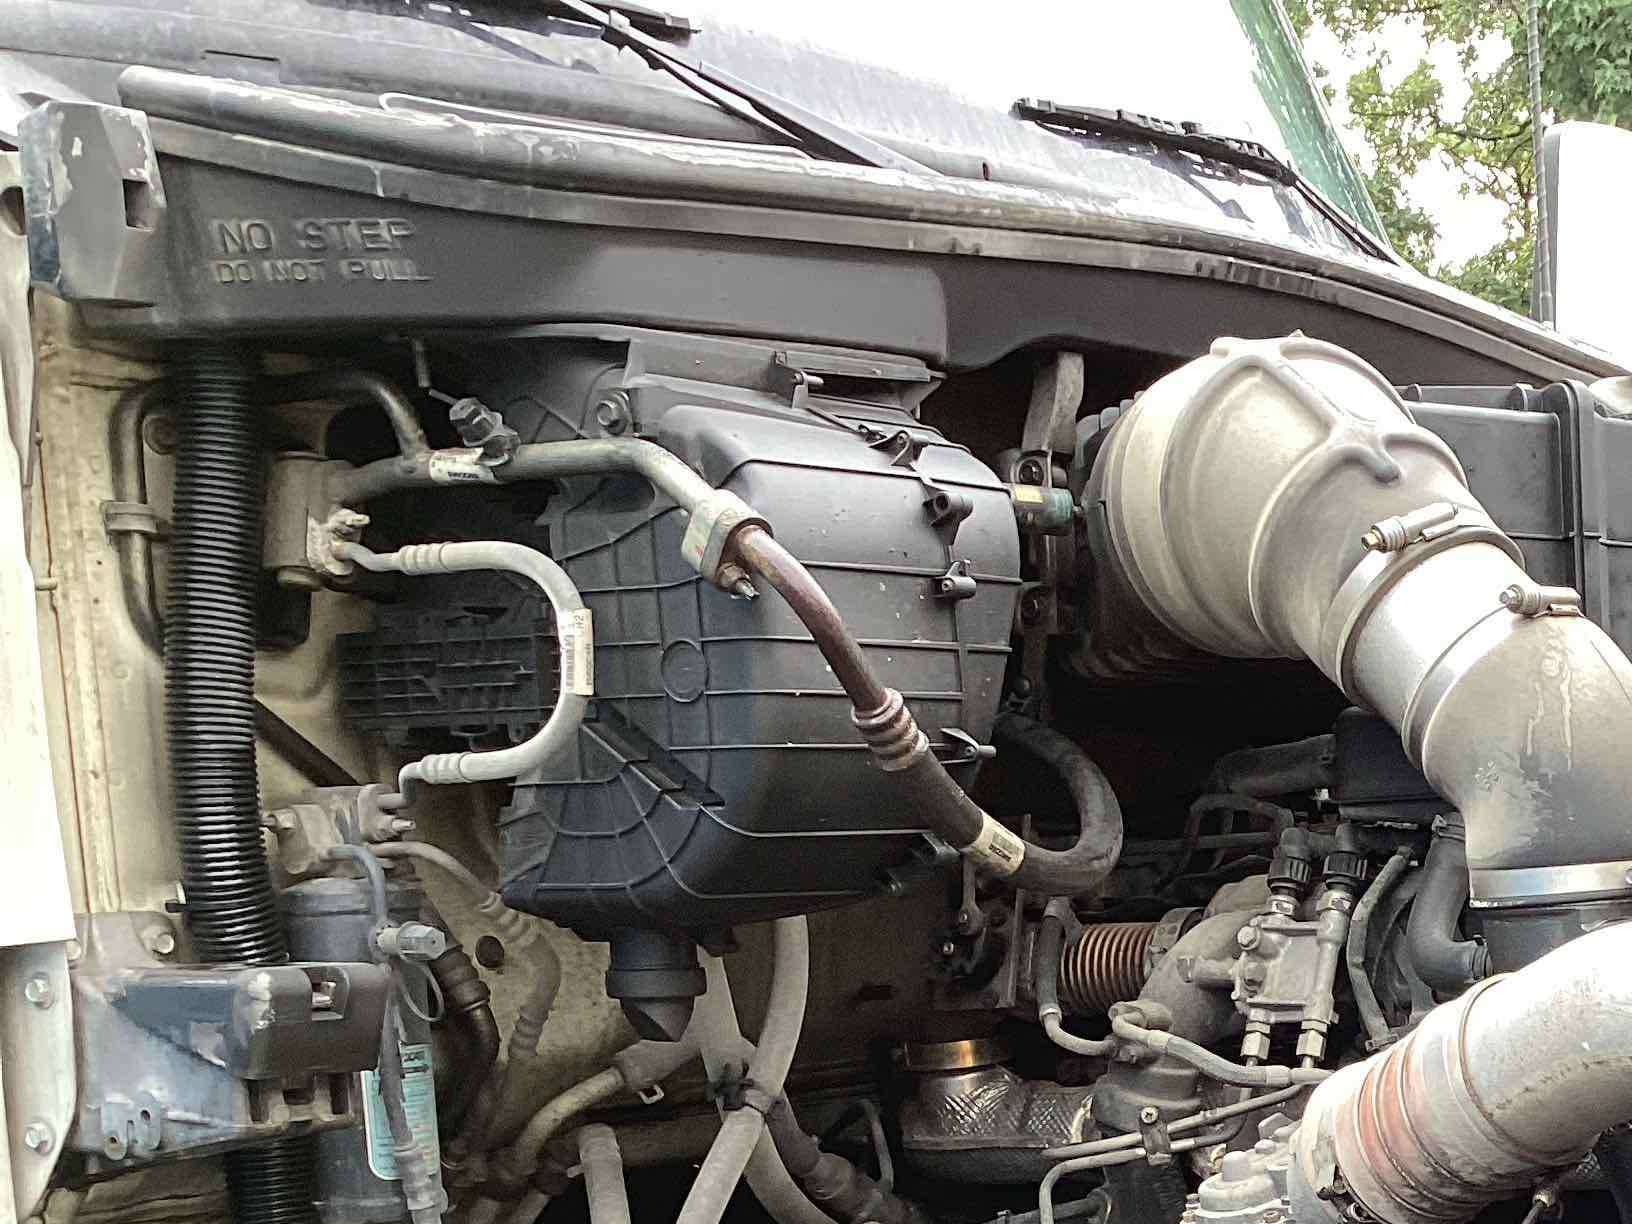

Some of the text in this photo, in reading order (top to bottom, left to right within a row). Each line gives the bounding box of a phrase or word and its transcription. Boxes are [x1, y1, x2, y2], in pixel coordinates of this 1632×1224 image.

[216, 217, 416, 254] NO STEP
[215, 258, 435, 283] DO NOT PULL
